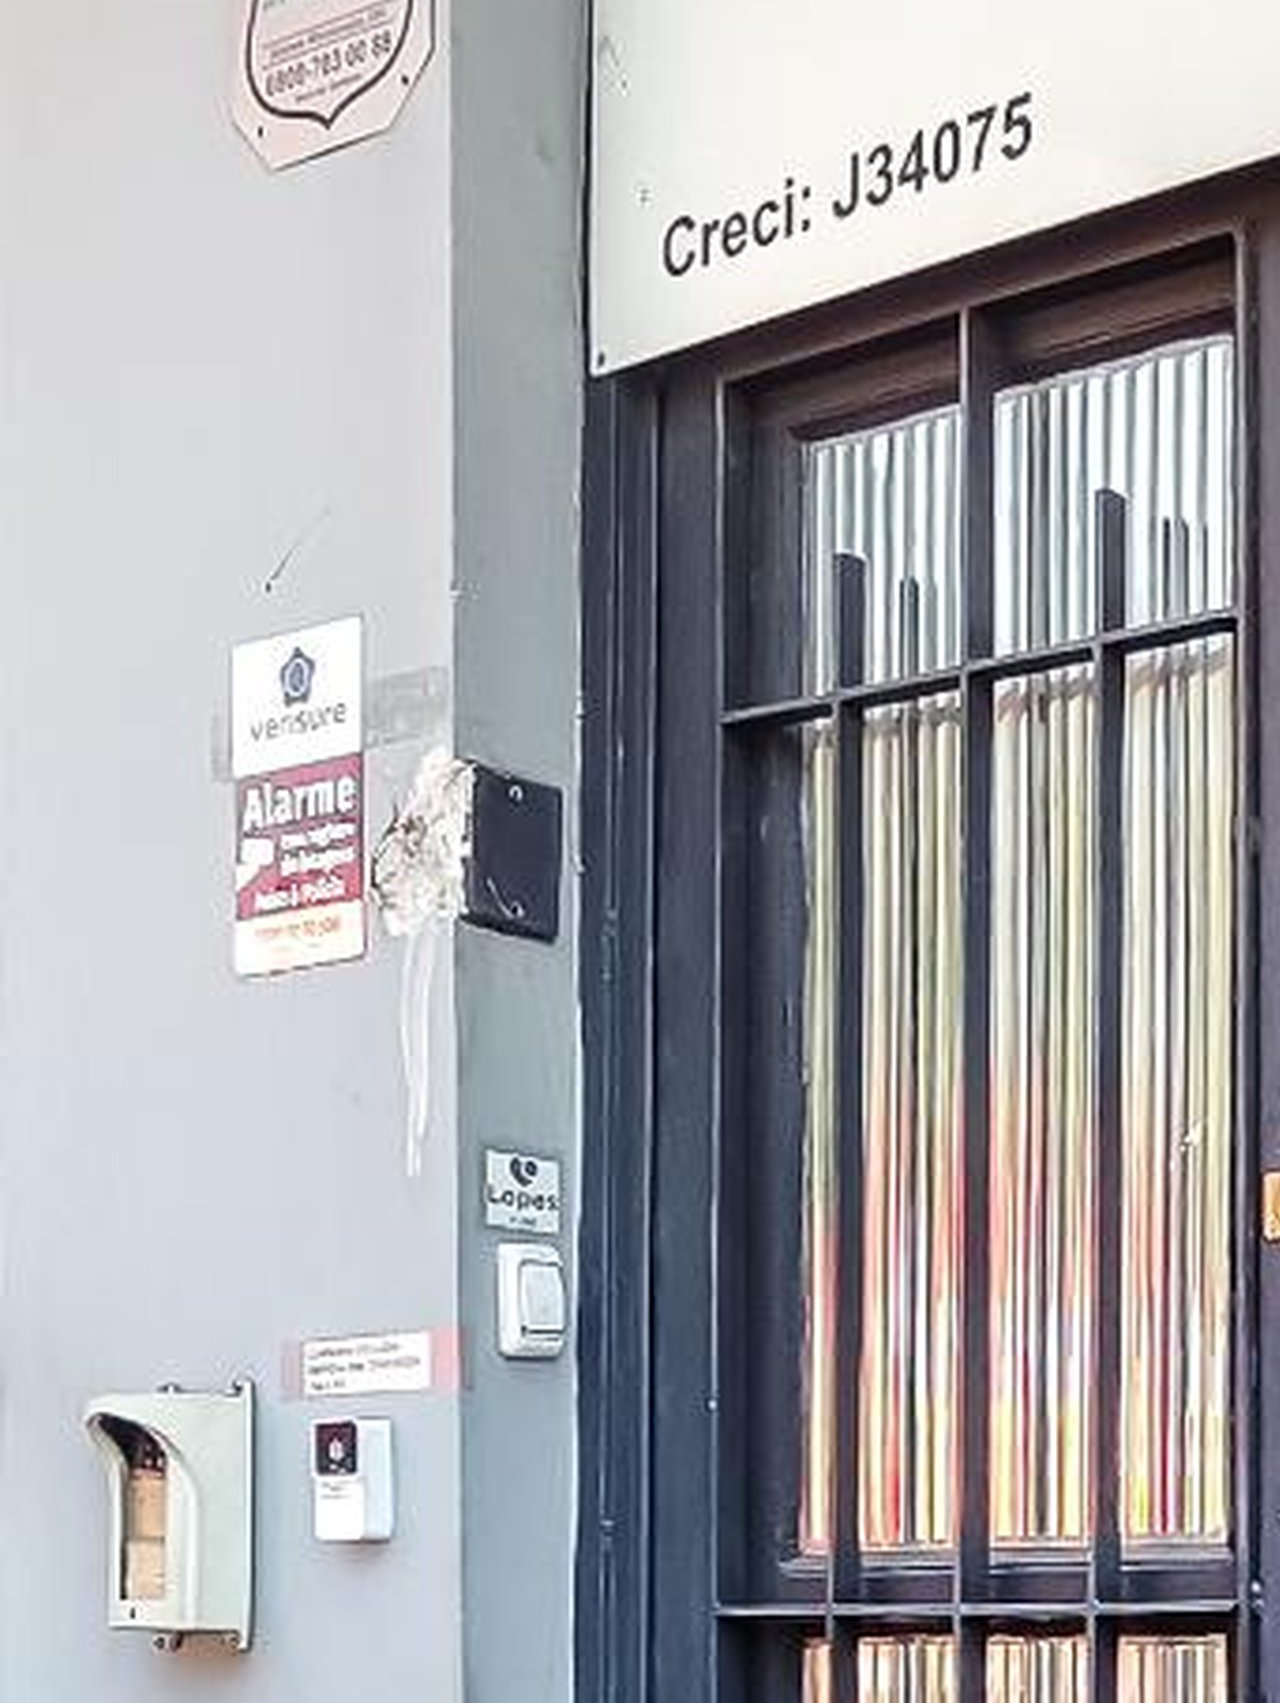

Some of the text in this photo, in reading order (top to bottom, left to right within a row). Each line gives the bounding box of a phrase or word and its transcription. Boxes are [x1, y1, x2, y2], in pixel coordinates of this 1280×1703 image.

[662, 92, 1032, 276] Creci: J34075
[244, 777, 355, 832] Alarme
